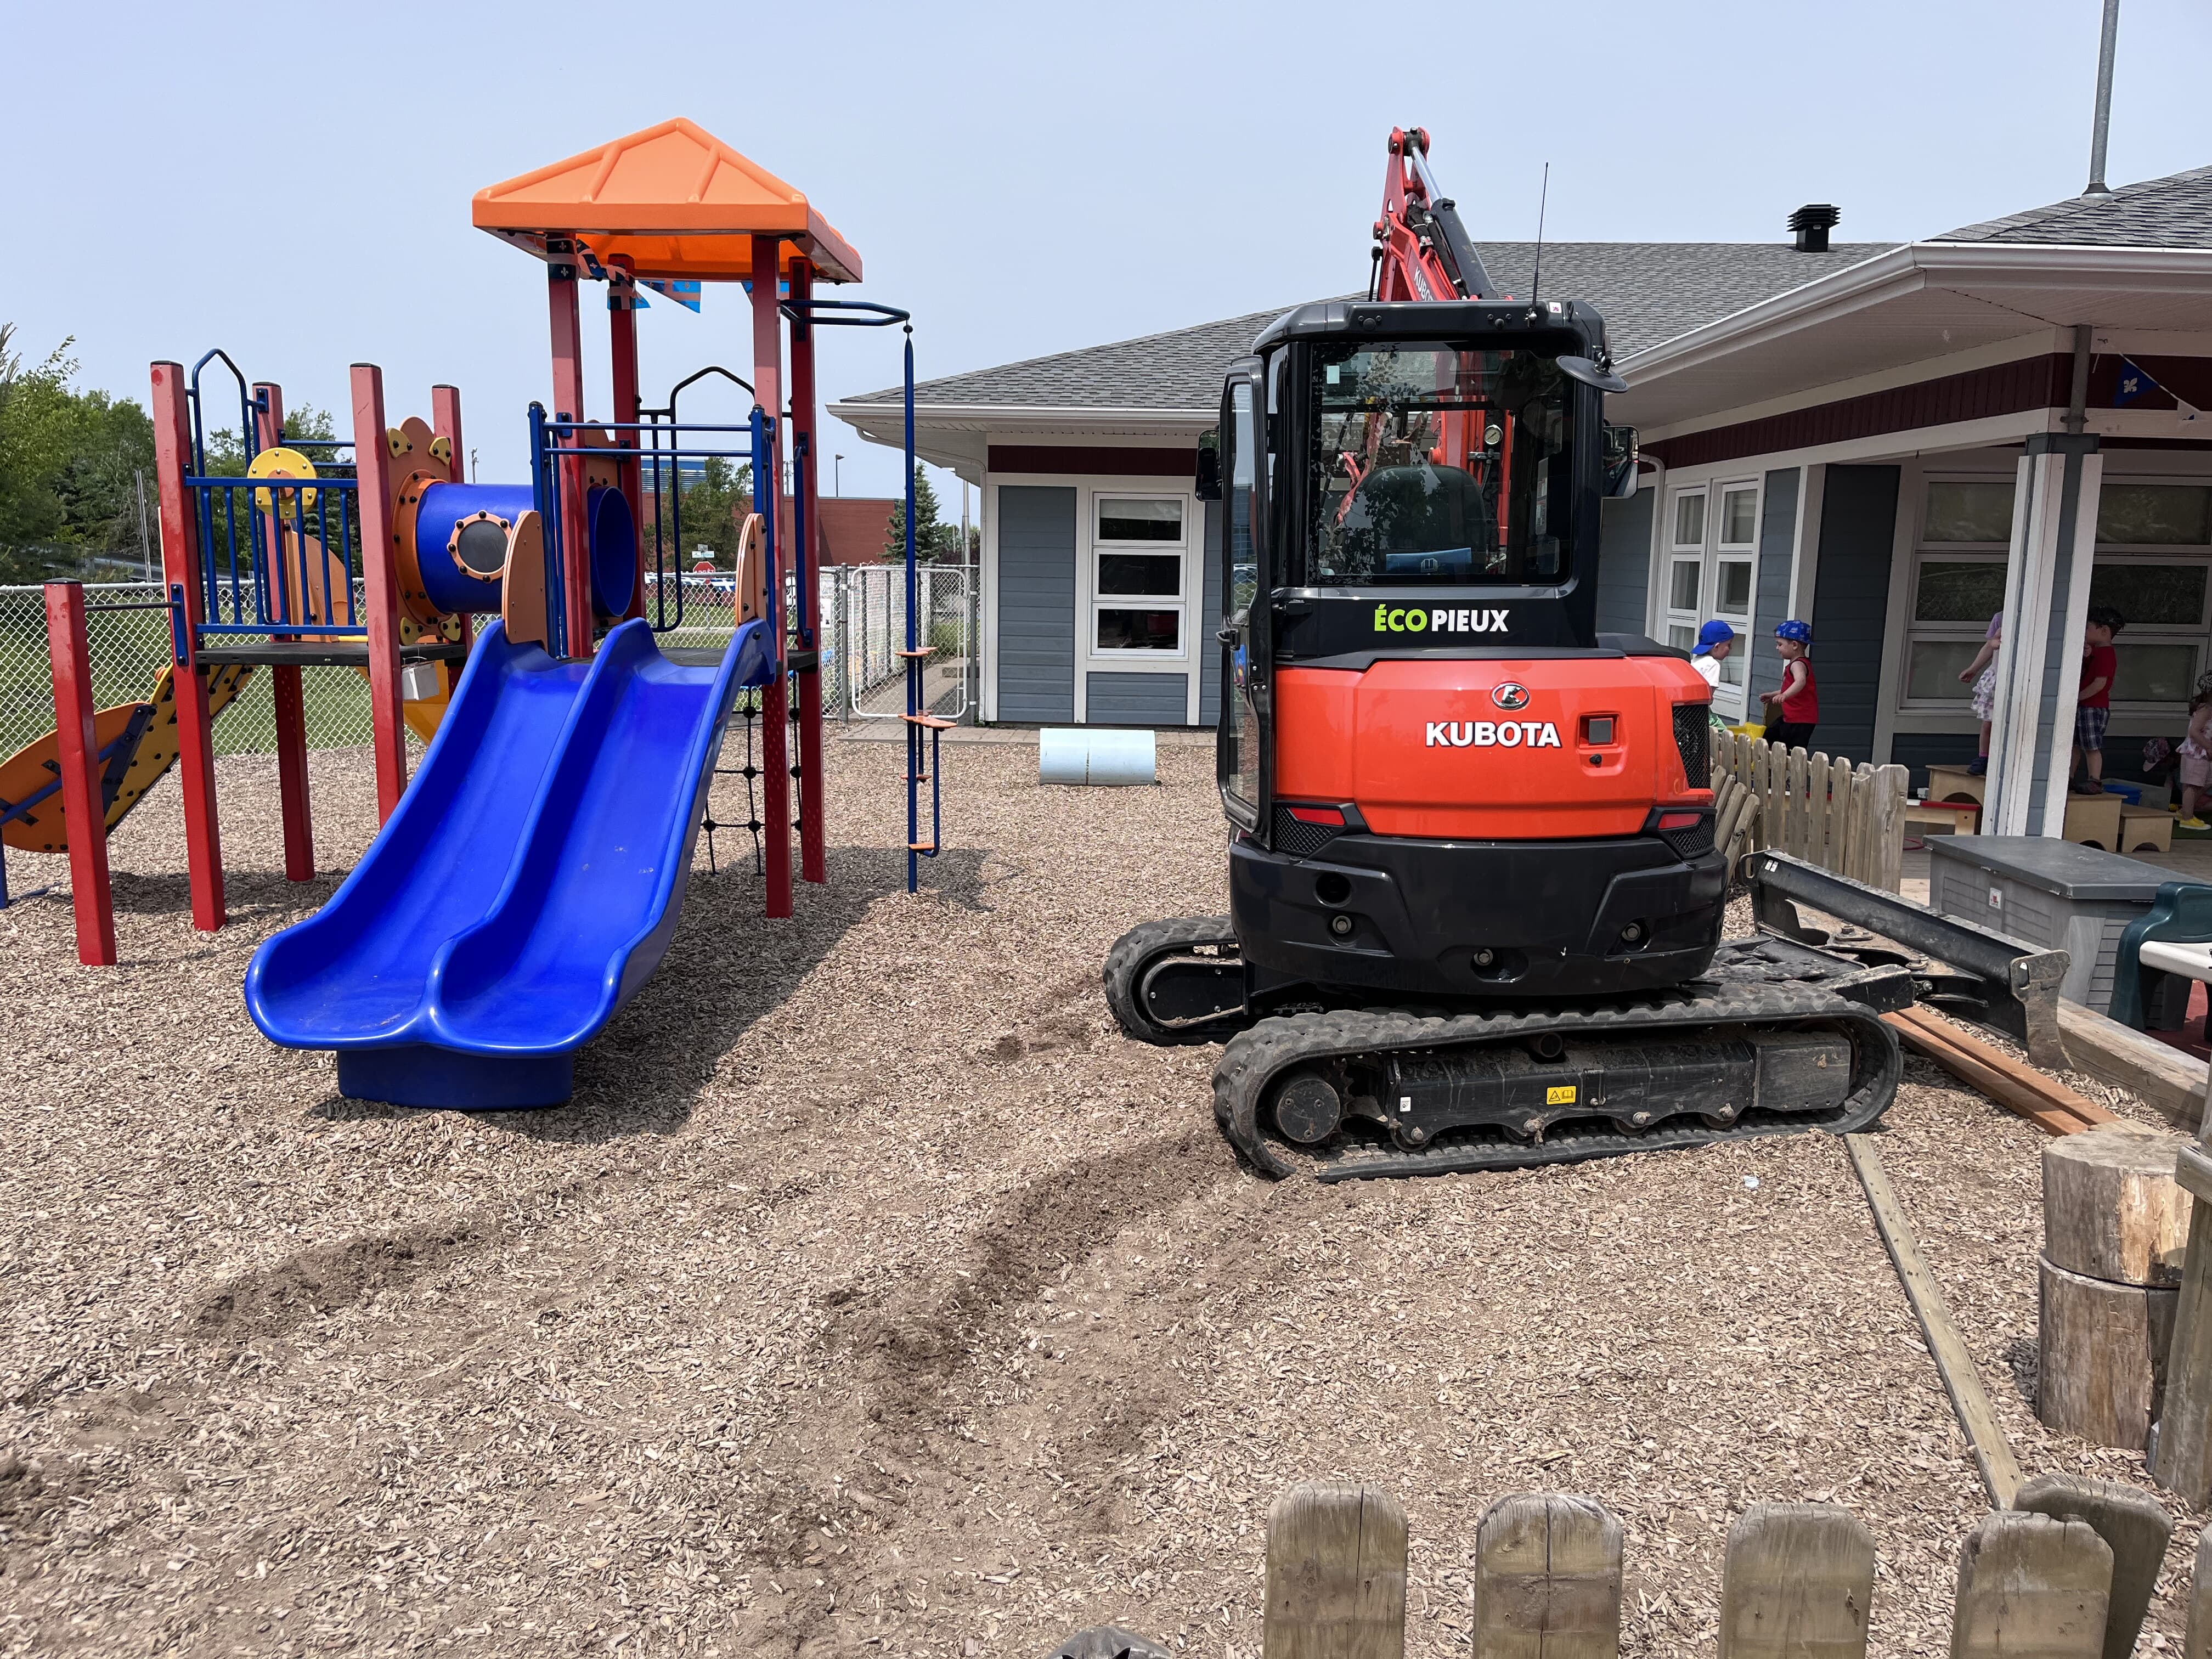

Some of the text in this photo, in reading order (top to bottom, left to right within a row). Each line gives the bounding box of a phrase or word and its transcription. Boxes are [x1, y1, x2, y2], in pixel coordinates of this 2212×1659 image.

[1414, 266, 1434, 301] KUBO
[1374, 604, 1510, 631] ÉCO PIEUX
[1426, 721, 1561, 747] KUBOTA
